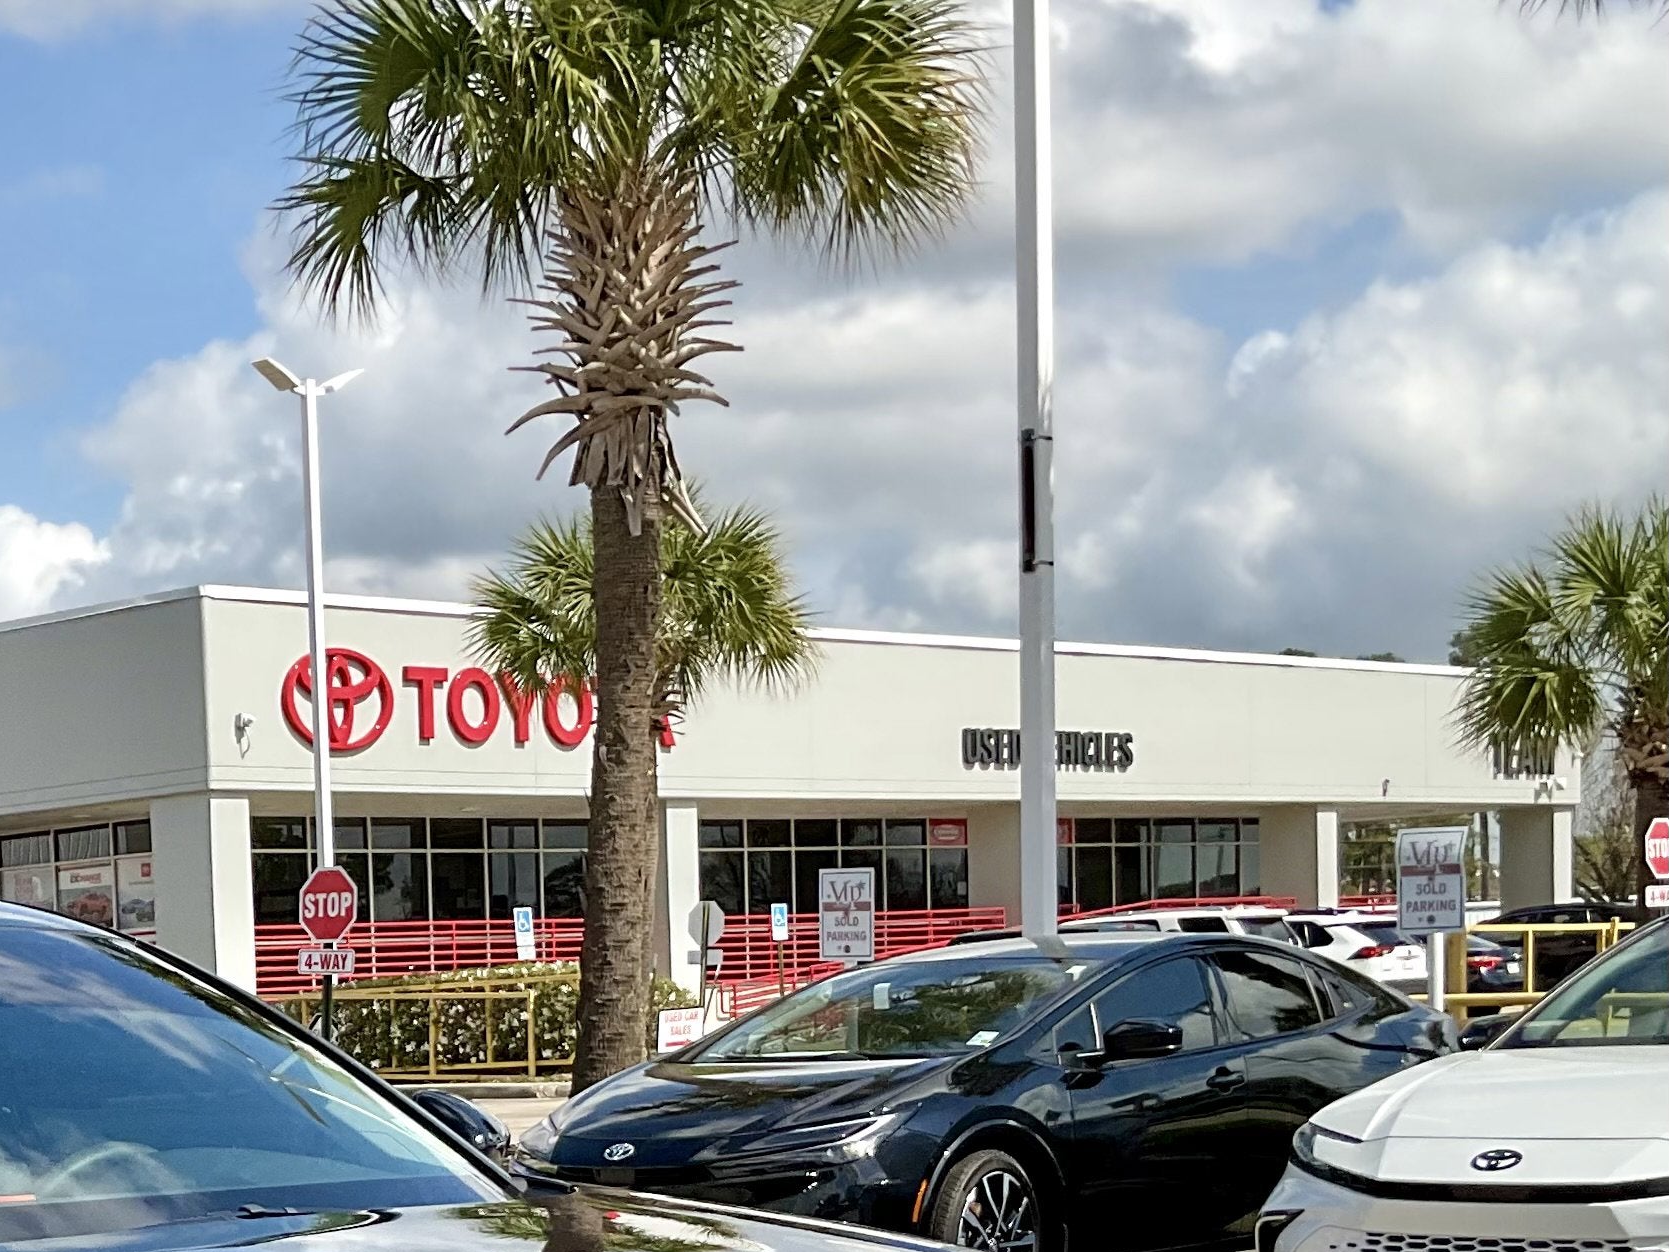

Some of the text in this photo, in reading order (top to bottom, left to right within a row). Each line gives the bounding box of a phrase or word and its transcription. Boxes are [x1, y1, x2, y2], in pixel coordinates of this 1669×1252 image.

[402, 666, 675, 747] TOYO
[1054, 731, 1134, 768] HICLES
[1648, 838, 1669, 858] STO
[1415, 883, 1447, 896] SOLD
[304, 892, 352, 918] STOP
[1405, 900, 1457, 912] PARKING
[835, 916, 860, 926] SOLD
[826, 931, 867, 941] PARKING
[304, 953, 348, 970] 4-WAY
